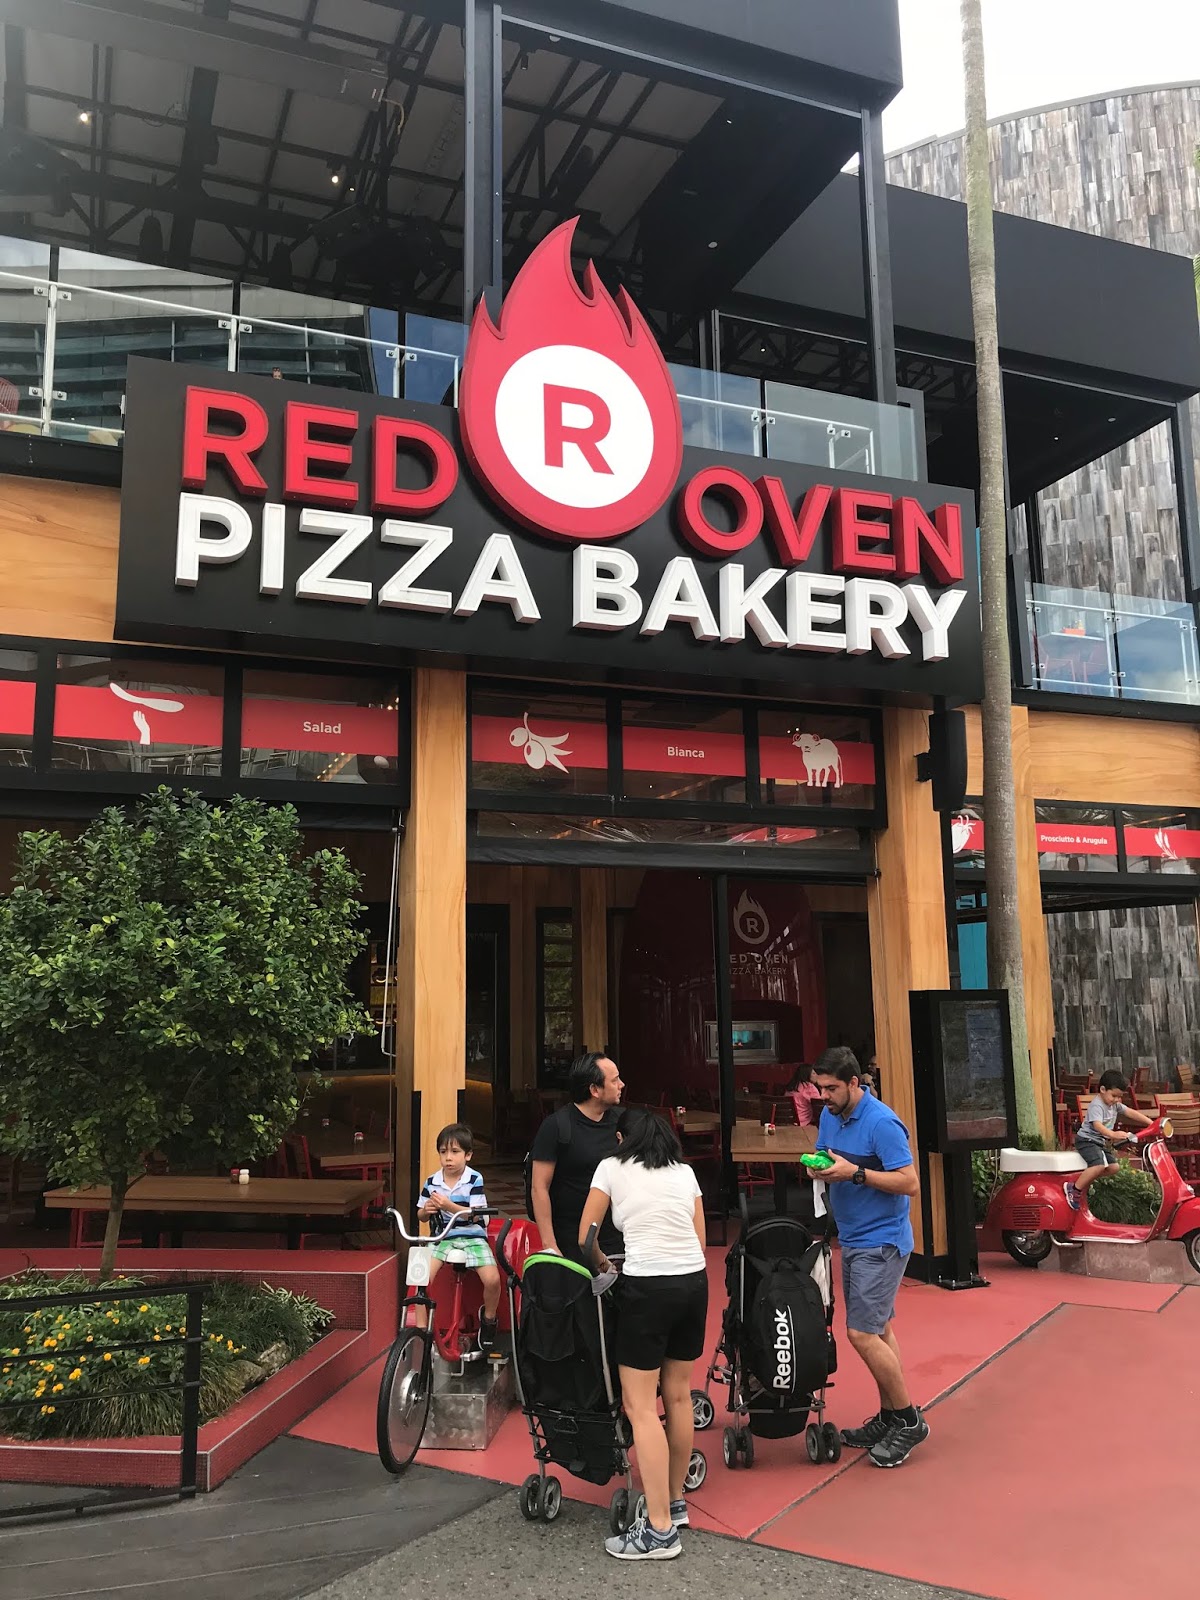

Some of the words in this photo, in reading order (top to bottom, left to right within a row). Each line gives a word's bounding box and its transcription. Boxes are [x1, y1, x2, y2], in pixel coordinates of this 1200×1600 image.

[543, 383, 615, 475] R
[182, 385, 459, 516] RED
[678, 466, 965, 584] OVEN
[175, 492, 541, 624] PIZZA
[573, 544, 967, 662] BAKERY
[303, 721, 342, 734] Salad
[667, 746, 705, 758] Bianca
[1040, 835, 1074, 843] Prosciutto
[746, 918, 759, 933] R
[729, 953, 748, 963] ED
[754, 954, 788, 964] OVEN
[729, 967, 752, 975] IZZA
[754, 967, 788, 975] BAKERY
[772, 1308, 791, 1389] Reebok
